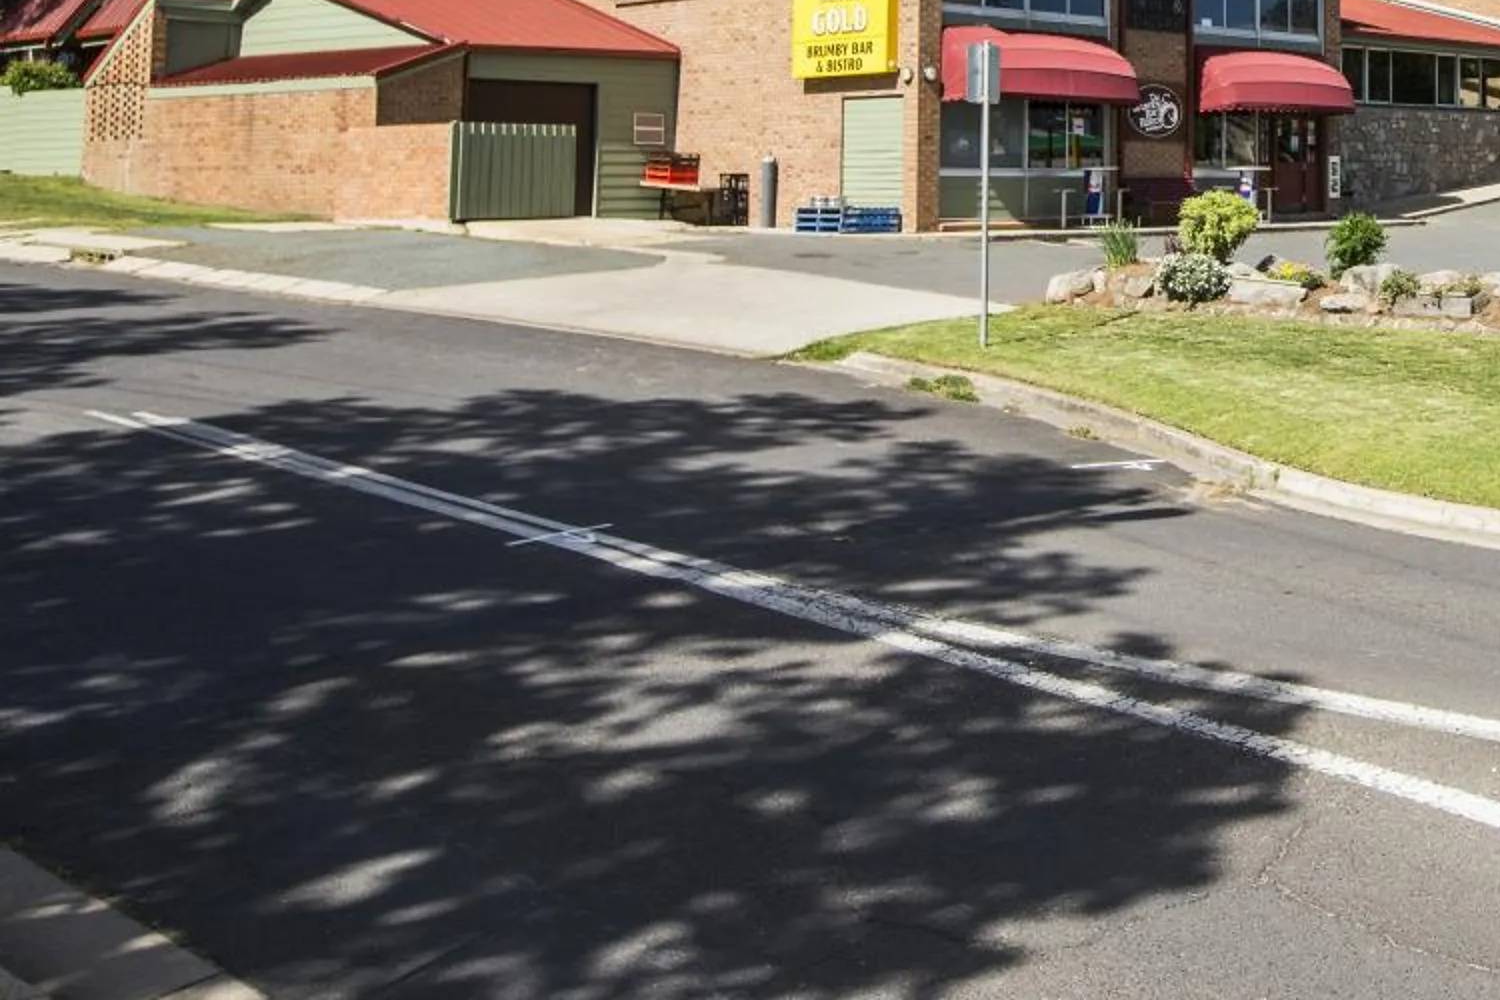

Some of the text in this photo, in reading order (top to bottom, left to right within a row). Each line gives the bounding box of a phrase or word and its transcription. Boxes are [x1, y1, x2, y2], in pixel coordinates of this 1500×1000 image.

[812, 3, 867, 35] GOLD
[807, 41, 873, 59] BRUMBY BAR
[816, 58, 863, 73] & BISTRO
